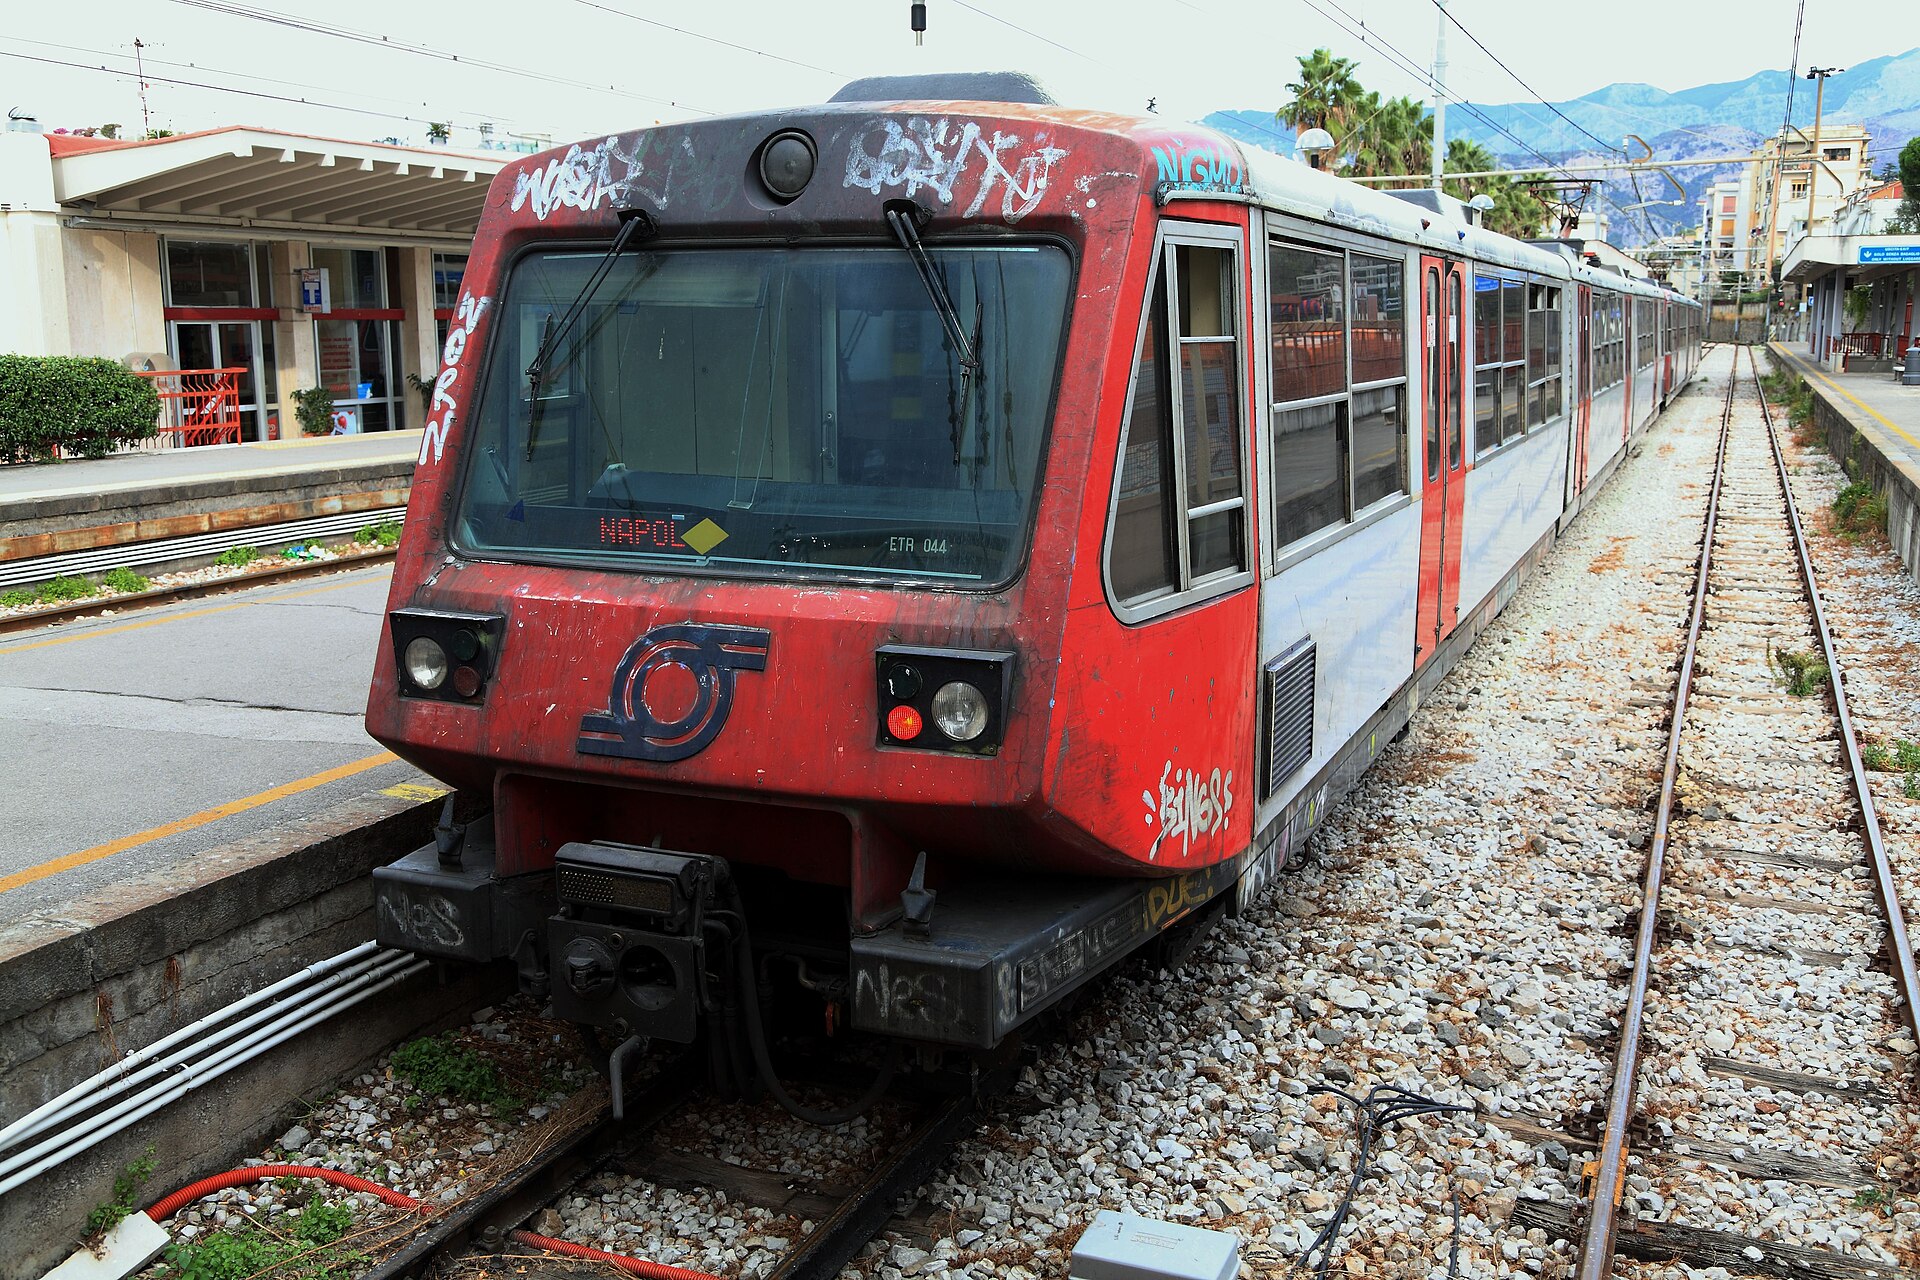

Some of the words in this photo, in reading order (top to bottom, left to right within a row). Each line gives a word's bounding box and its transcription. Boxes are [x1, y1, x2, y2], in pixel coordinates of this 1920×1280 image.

[304, 282, 320, 304] T
[600, 517, 686, 548] NAPOL
[889, 536, 914, 552] ETR
[923, 538, 947, 554] 044
